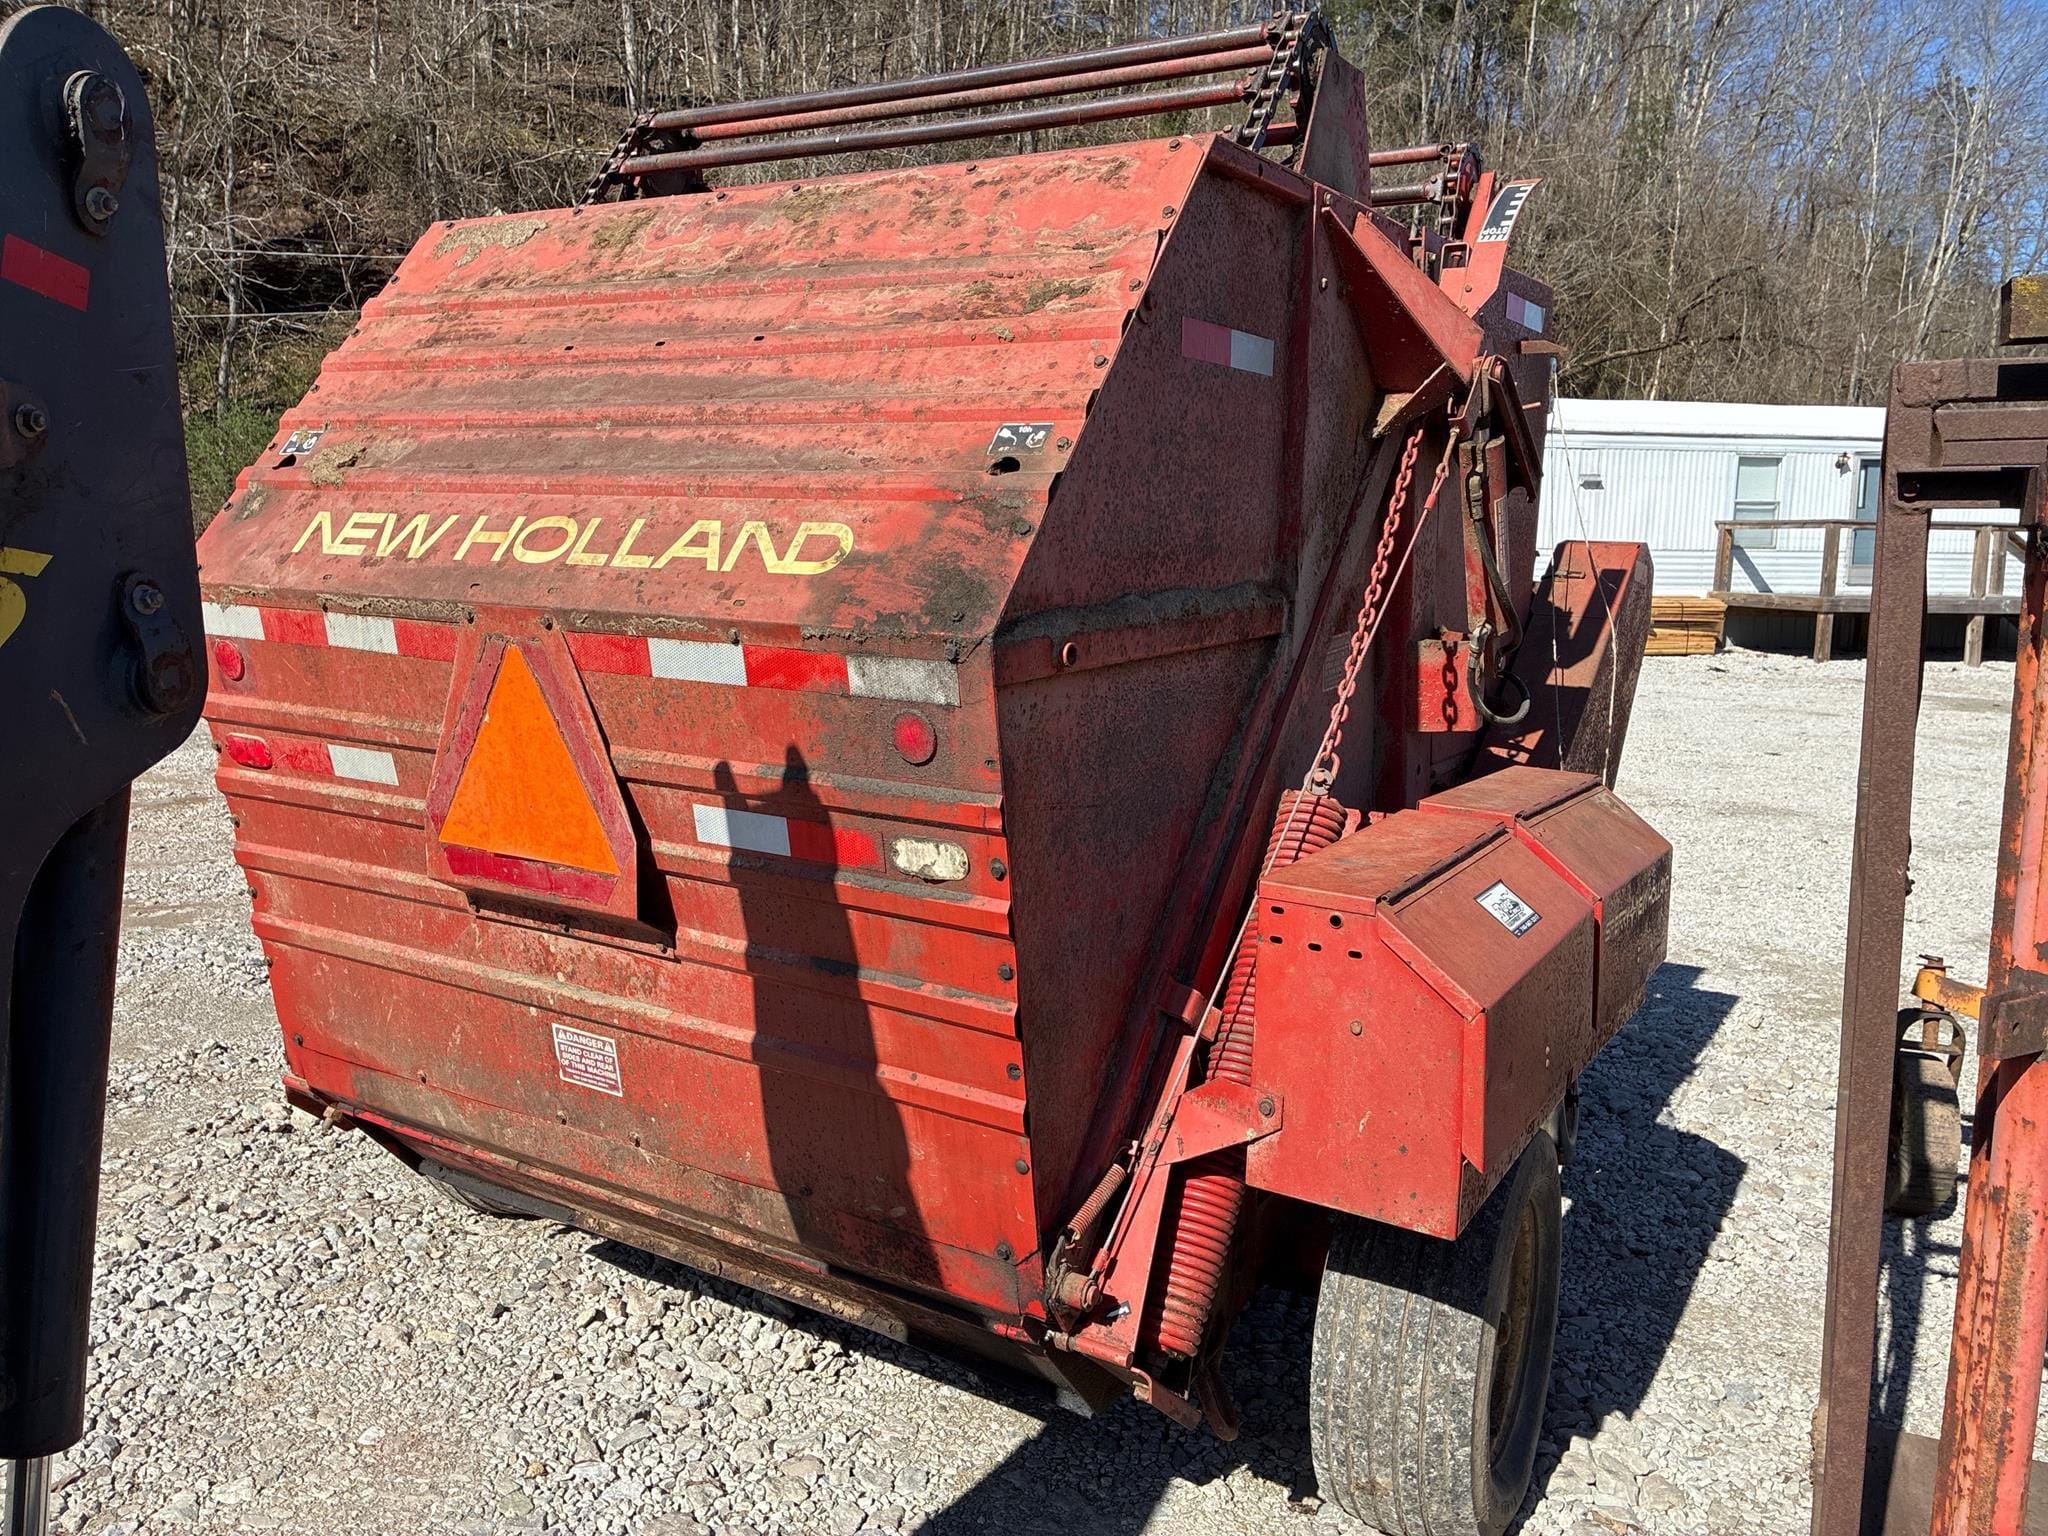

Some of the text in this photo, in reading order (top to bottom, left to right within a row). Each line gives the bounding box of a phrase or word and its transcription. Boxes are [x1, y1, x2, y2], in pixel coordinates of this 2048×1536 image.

[1482, 226, 1509, 235] STOP
[292, 511, 854, 576] NEW HOLLAND
[566, 1032, 604, 1049] DANGER
[560, 1044, 582, 1056] STAND
[583, 1050, 604, 1062] CLEAR
[562, 1052, 614, 1072] SIDES AND REAR
[571, 1061, 586, 1071] THIS
[587, 1066, 617, 1079] MACHINE
